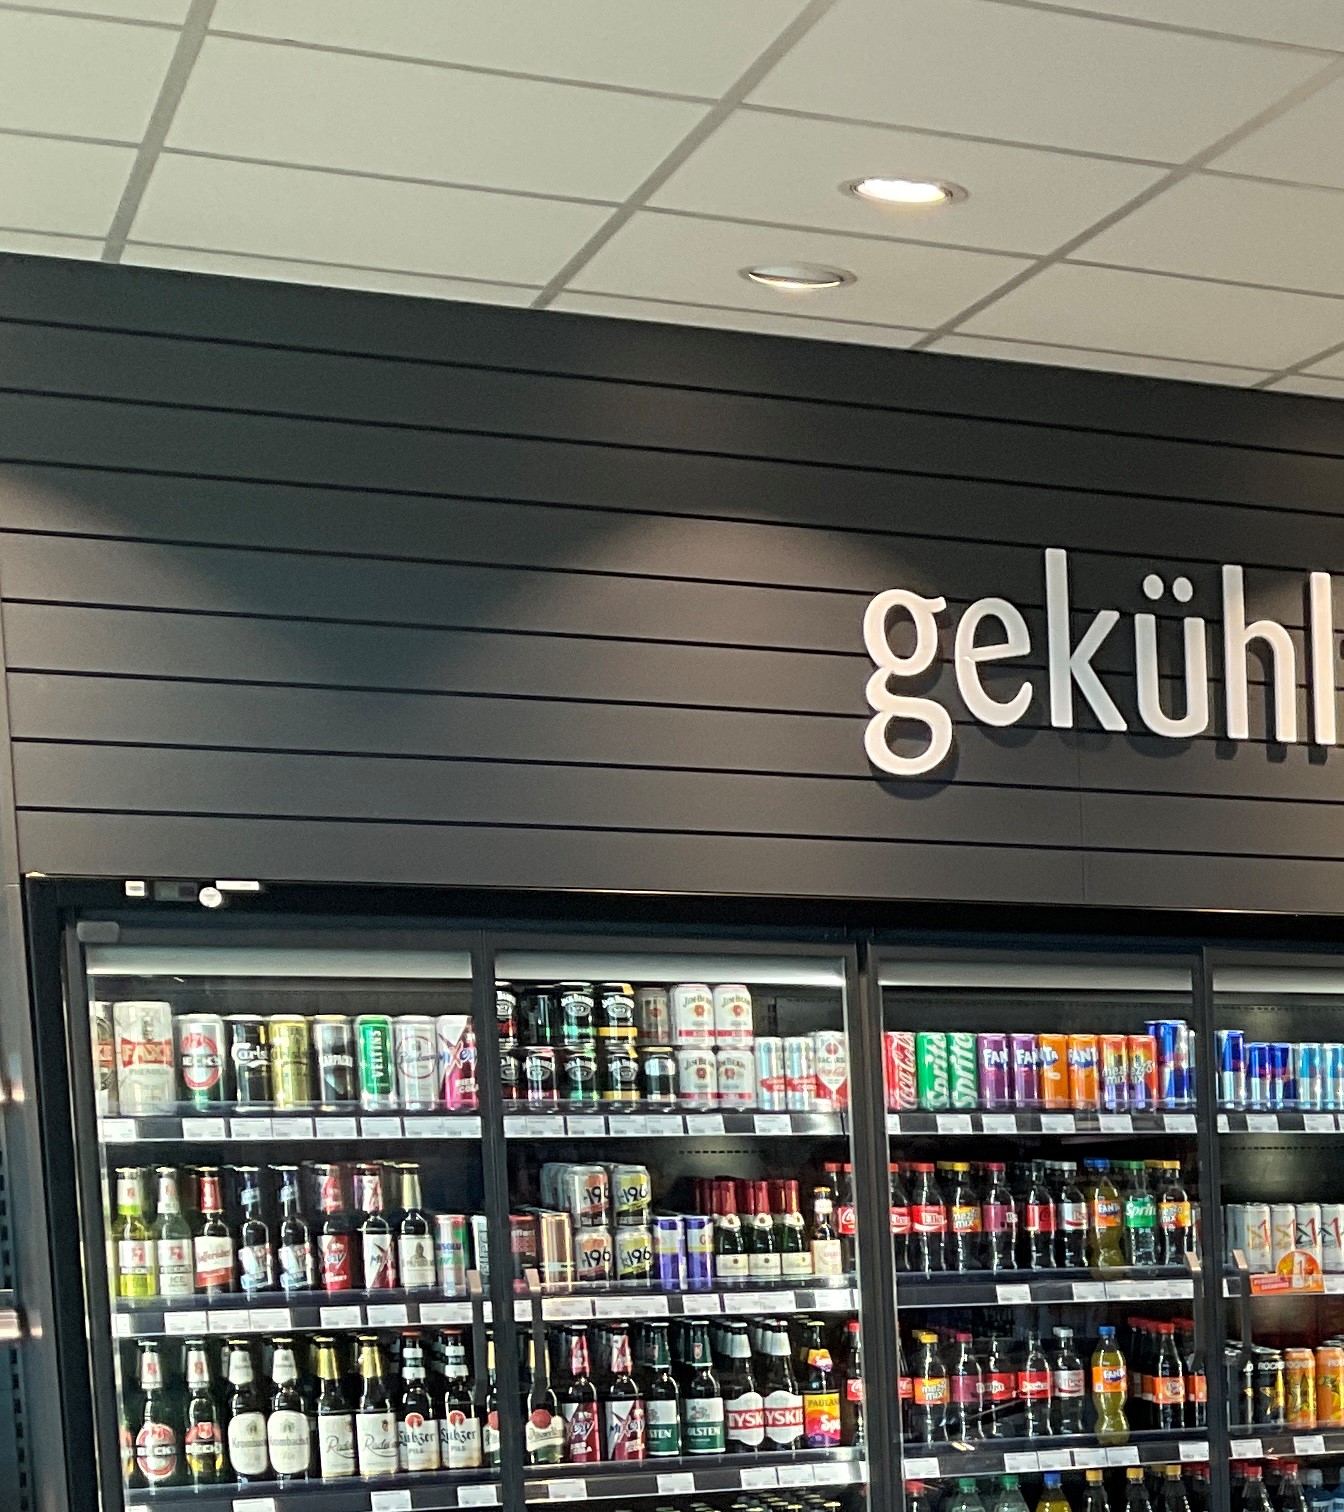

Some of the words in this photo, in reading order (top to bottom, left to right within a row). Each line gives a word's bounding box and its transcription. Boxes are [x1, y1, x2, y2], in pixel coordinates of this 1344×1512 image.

[371, 1030, 385, 1078] VELTINS
[983, 1048, 1007, 1069] FAN
[728, 1413, 763, 1427] TYSK
[687, 1427, 722, 1437] OLSTEN
